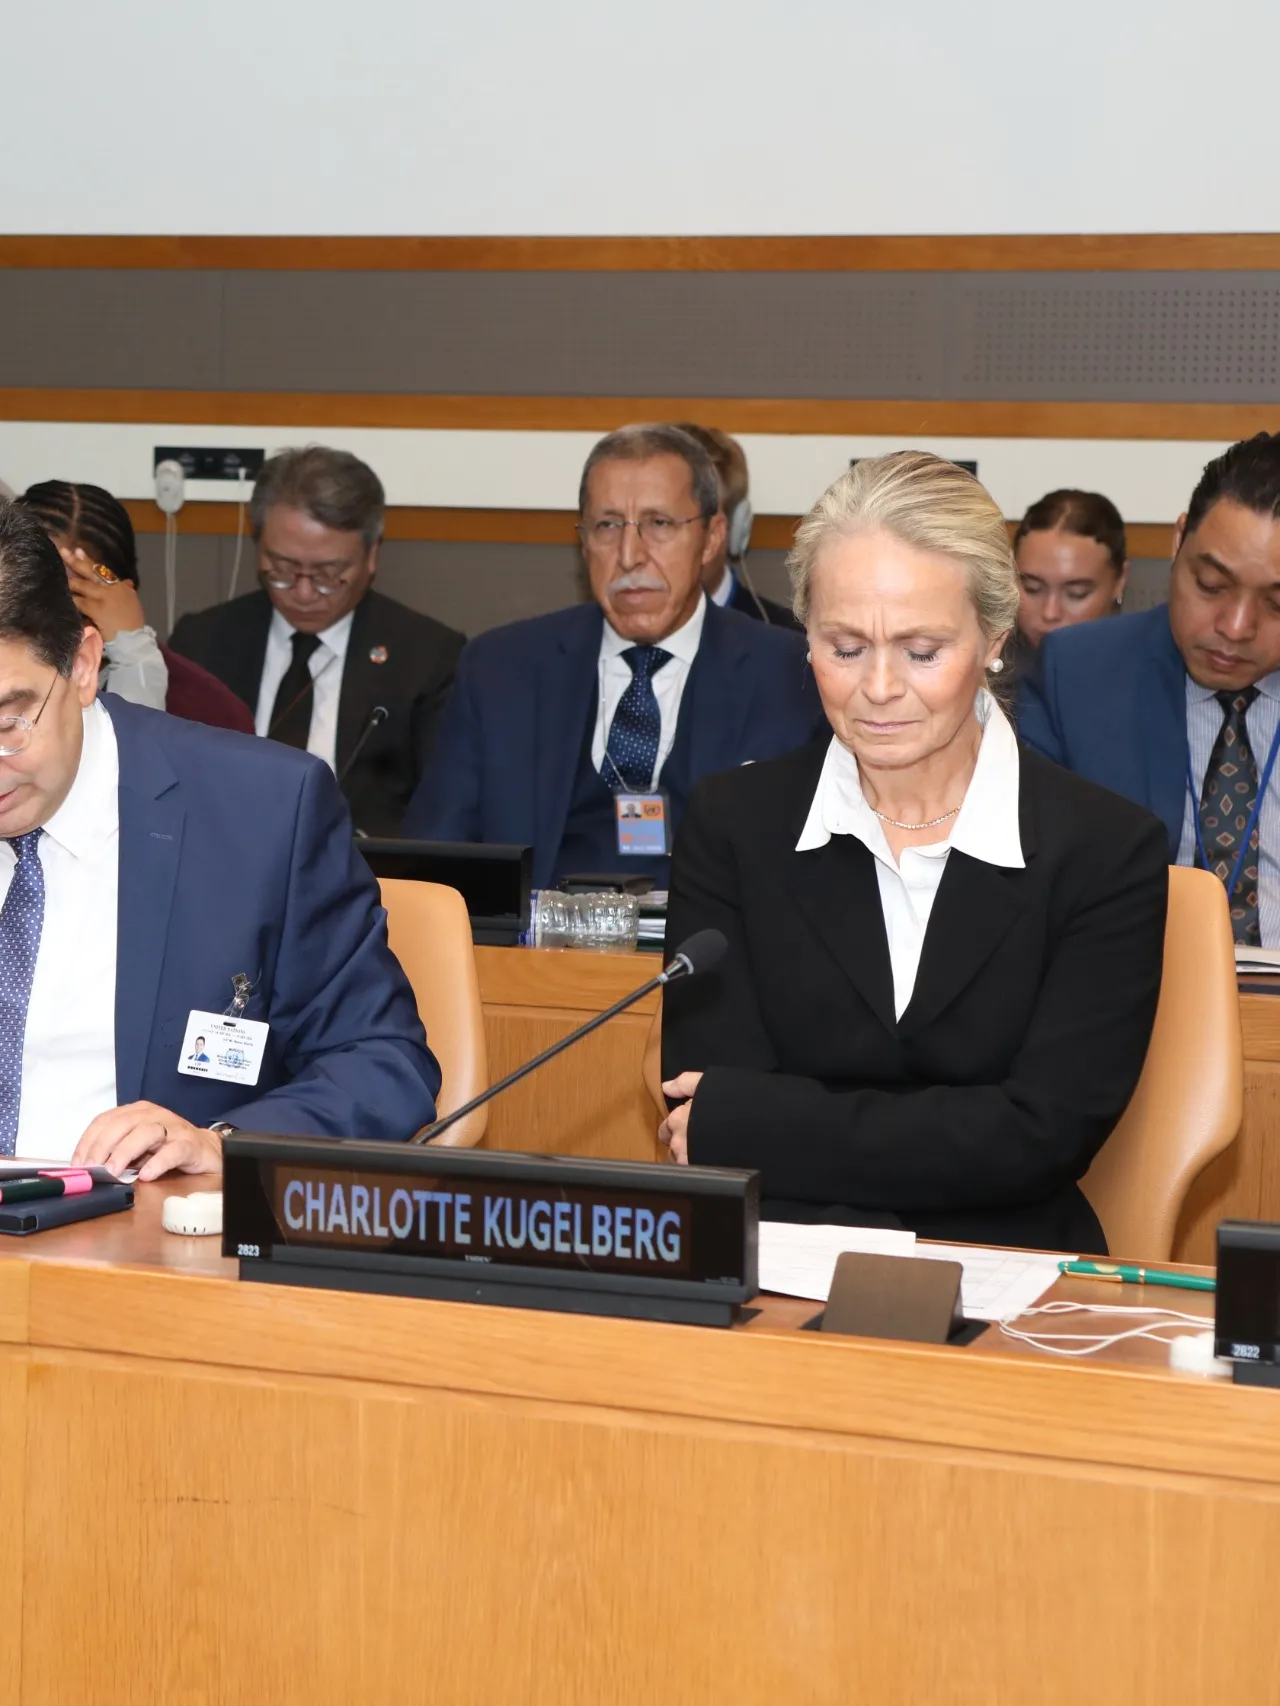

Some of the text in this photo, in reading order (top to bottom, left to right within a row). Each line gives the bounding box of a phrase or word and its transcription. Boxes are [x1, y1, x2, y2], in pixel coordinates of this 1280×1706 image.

[284, 1180, 681, 1262] CHARLOTTE KUGELBERG
[237, 1243, 260, 1257] 2823
[1231, 1343, 1260, 1359] 2822
